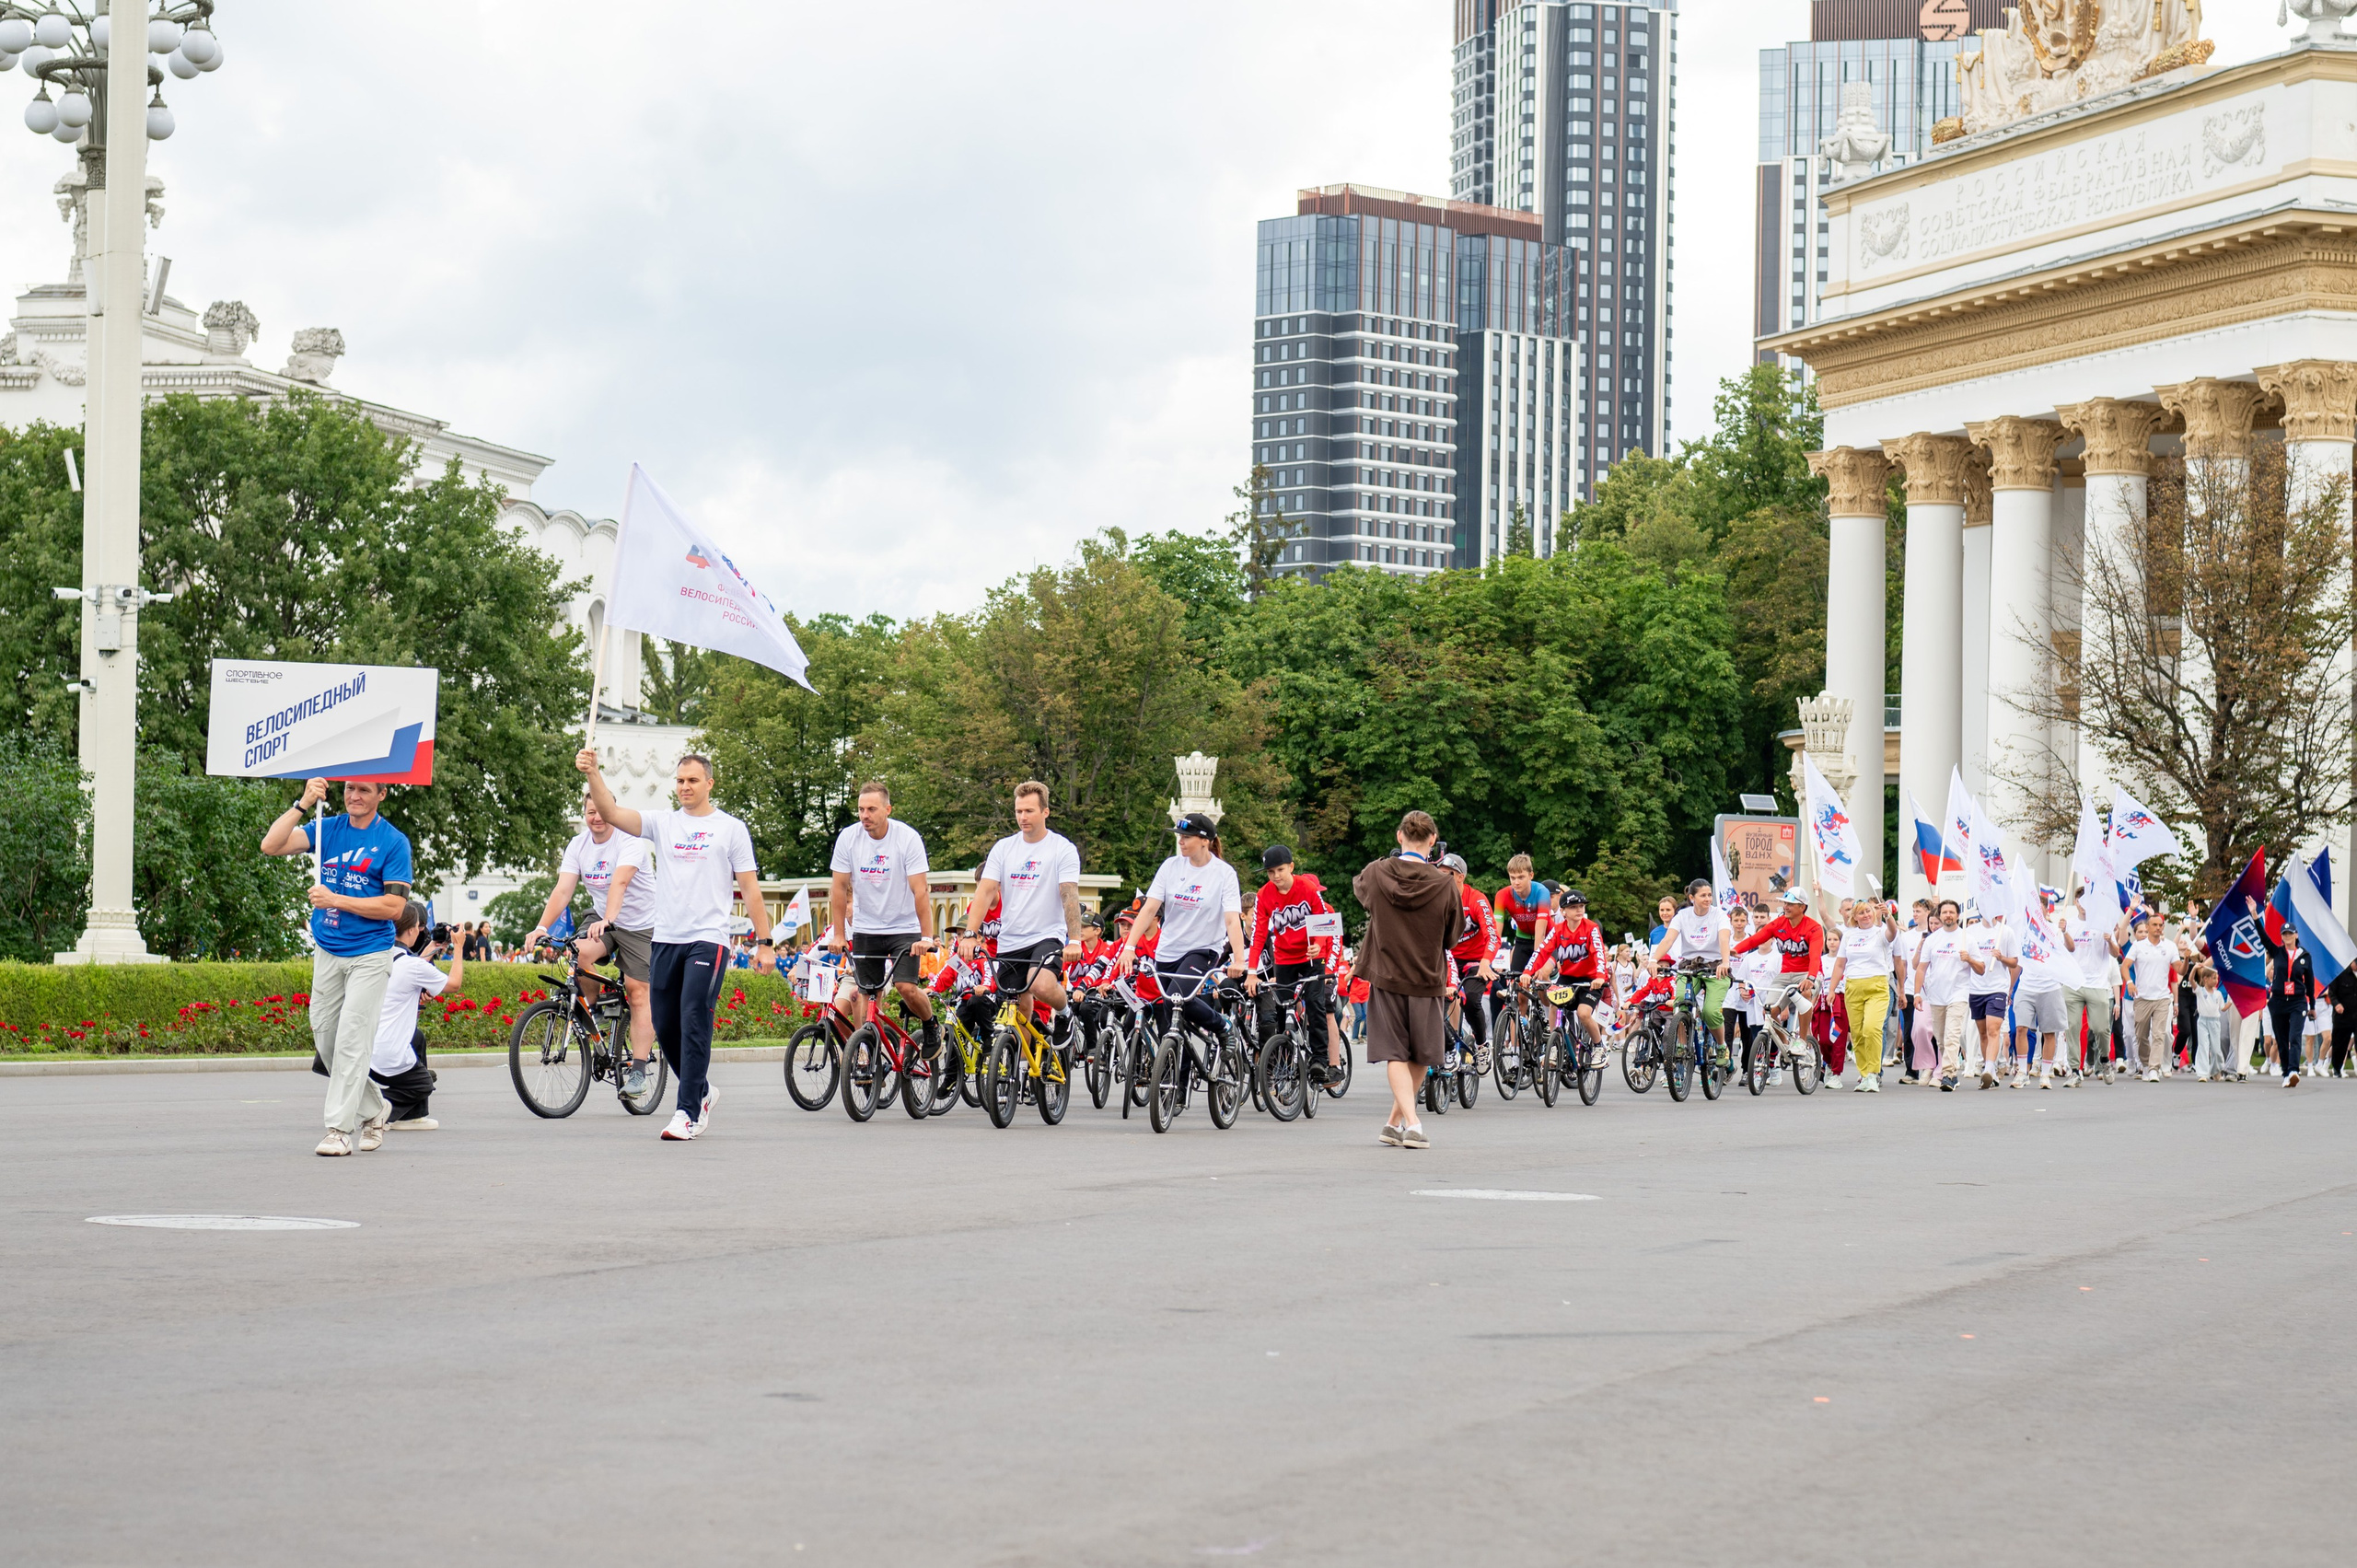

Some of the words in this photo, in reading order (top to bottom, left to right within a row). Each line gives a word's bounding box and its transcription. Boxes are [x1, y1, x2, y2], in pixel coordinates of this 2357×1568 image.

[1956, 131, 2145, 203] РОССИЙСКАЯ
[1920, 190, 2024, 236] СОВЕТСКАЯ
[2035, 143, 2191, 205] ФЕДЕРАТИВНАЯ
[1920, 200, 2076, 259] СОЦИАЛИСТИЧЕСКАЯ
[2085, 169, 2194, 217] РЕСПУБЛИКА
[246, 671, 366, 745] ВЕЛОСИПЕДНЫЙ
[244, 731, 290, 769] СПОРТ
[1746, 837, 1772, 851] ГОРОД
[1741, 891, 1759, 908] 30
[2215, 939, 2233, 970] РОССИИ
[1553, 991, 1569, 1001] 115
